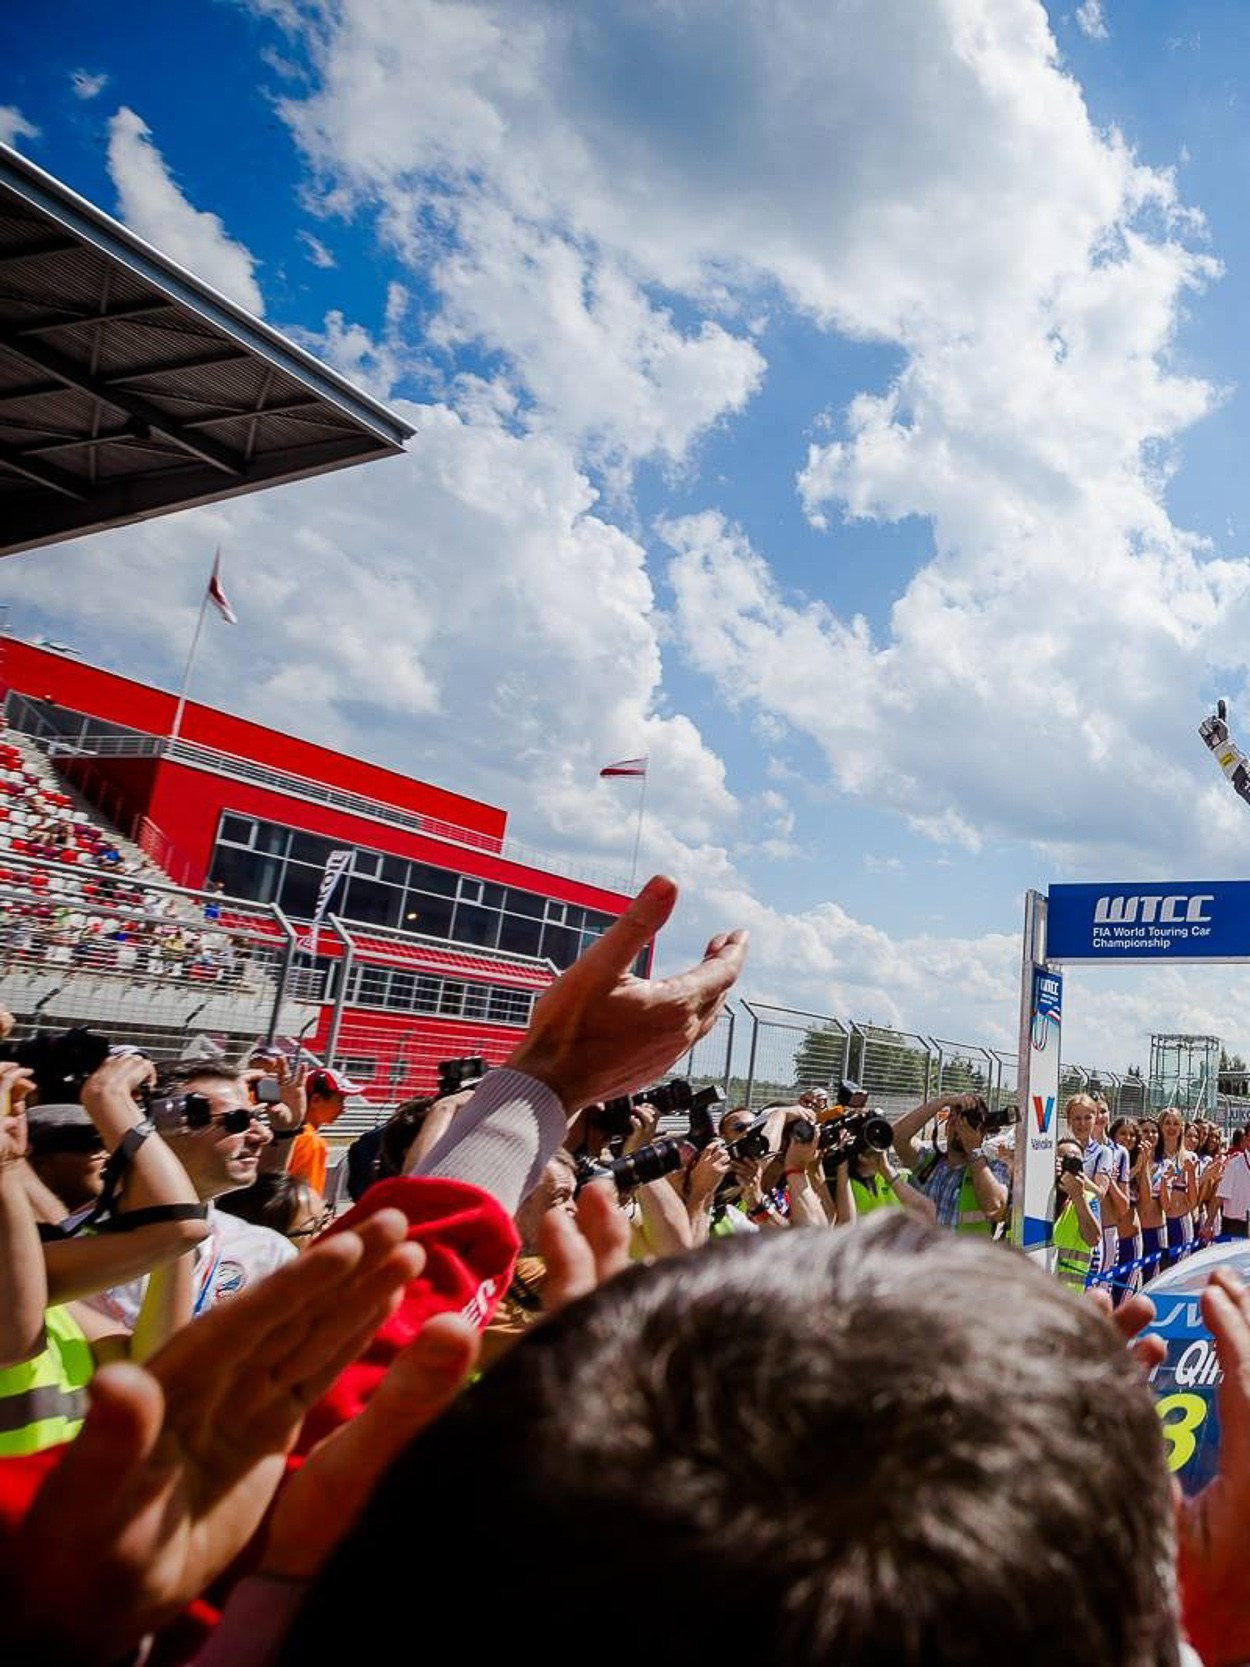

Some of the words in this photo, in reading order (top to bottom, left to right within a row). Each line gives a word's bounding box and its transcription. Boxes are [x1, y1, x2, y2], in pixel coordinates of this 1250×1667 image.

[1094, 895, 1214, 924] WTCC
[1093, 927, 1111, 937] FIA
[1113, 926, 1145, 937] World
[1148, 926, 1188, 939] Touring
[1191, 925, 1211, 937] Car
[1093, 938, 1171, 949] Championship
